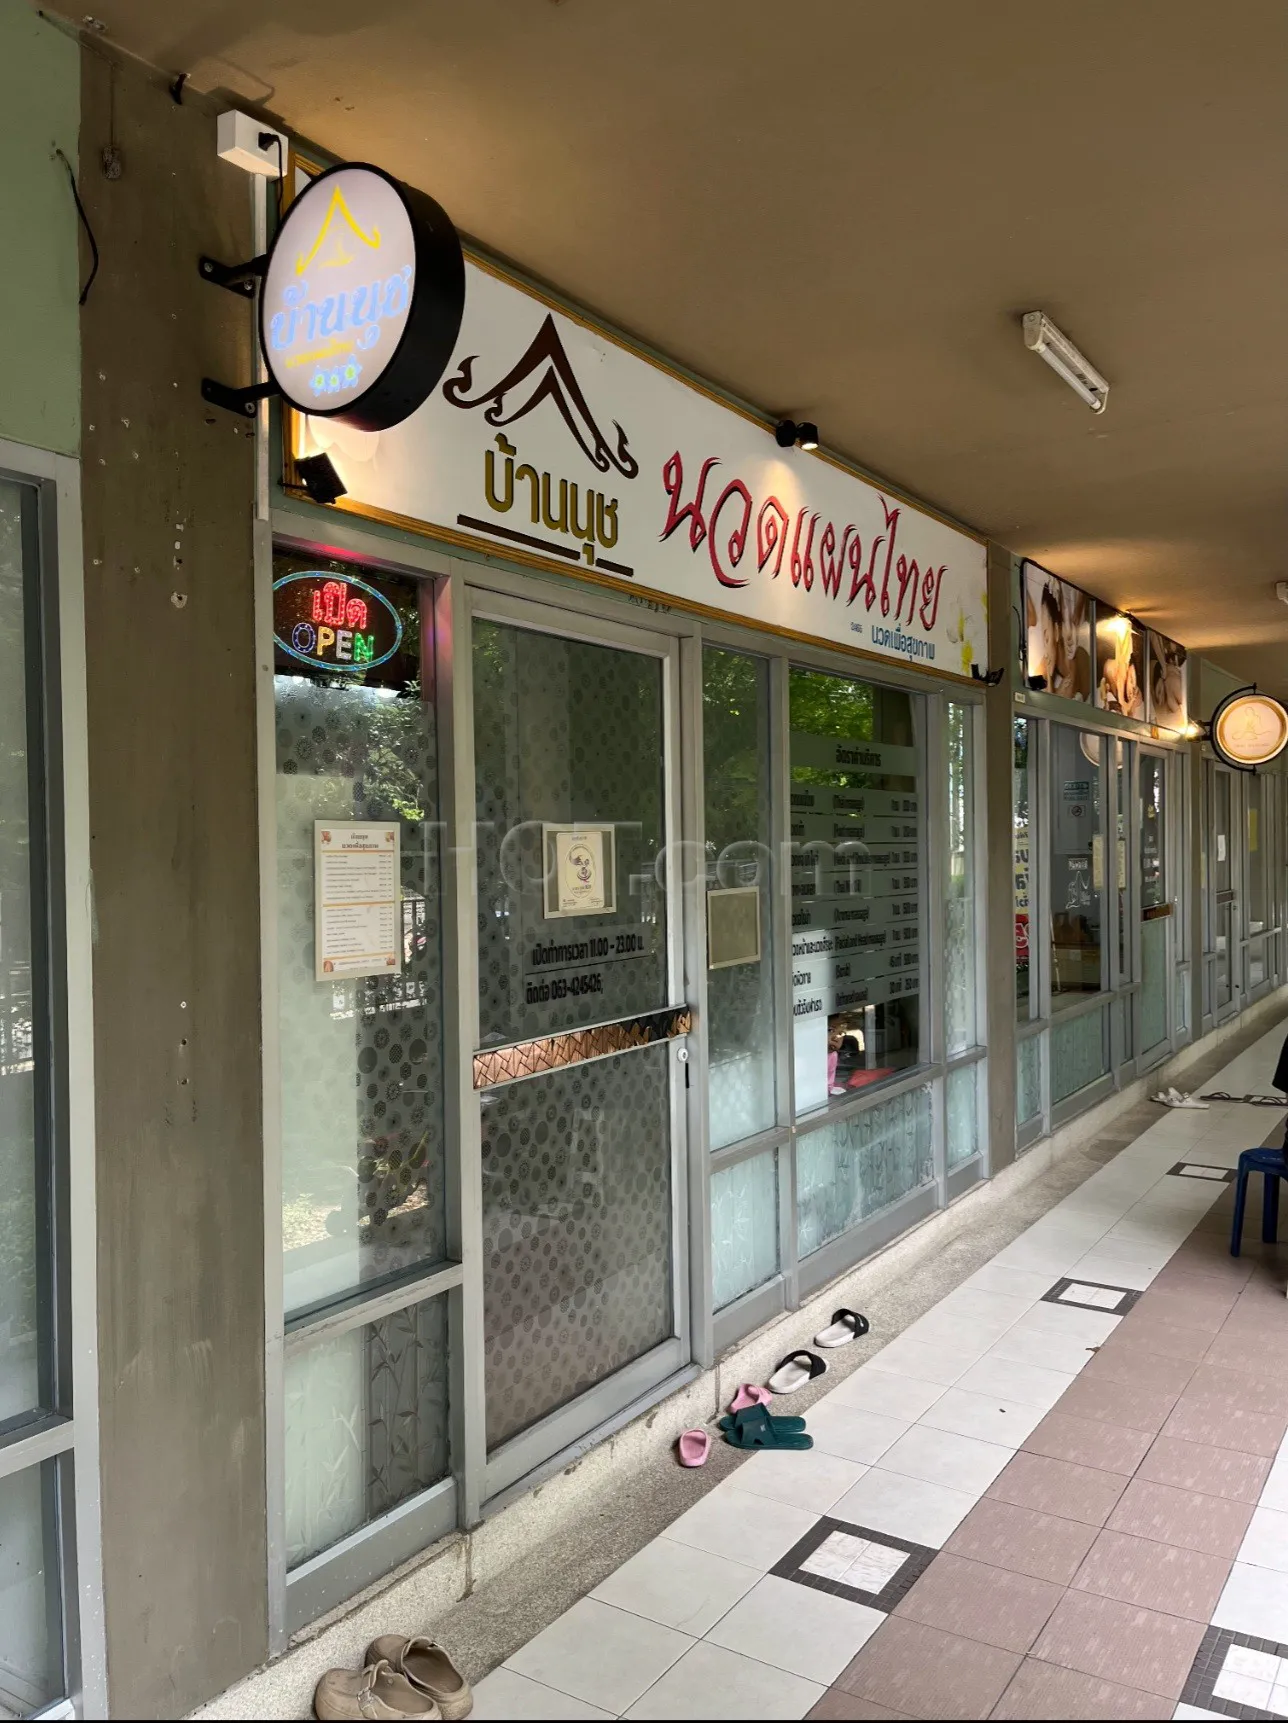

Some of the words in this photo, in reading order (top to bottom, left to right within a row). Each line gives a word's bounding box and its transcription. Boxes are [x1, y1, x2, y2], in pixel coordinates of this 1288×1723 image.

[484, 433, 619, 565] บ้านนุช
[659, 450, 949, 631] นวดแผนไทย
[312, 581, 367, 629] เปิด
[291, 621, 375, 663] OPEN
[871, 623, 935, 661] นวดเพื่อสุขภาพ
[589, 937, 609, 957] 11.00
[615, 934, 636, 954] 23.00
[526, 979, 549, 1004] ติดต่อ
